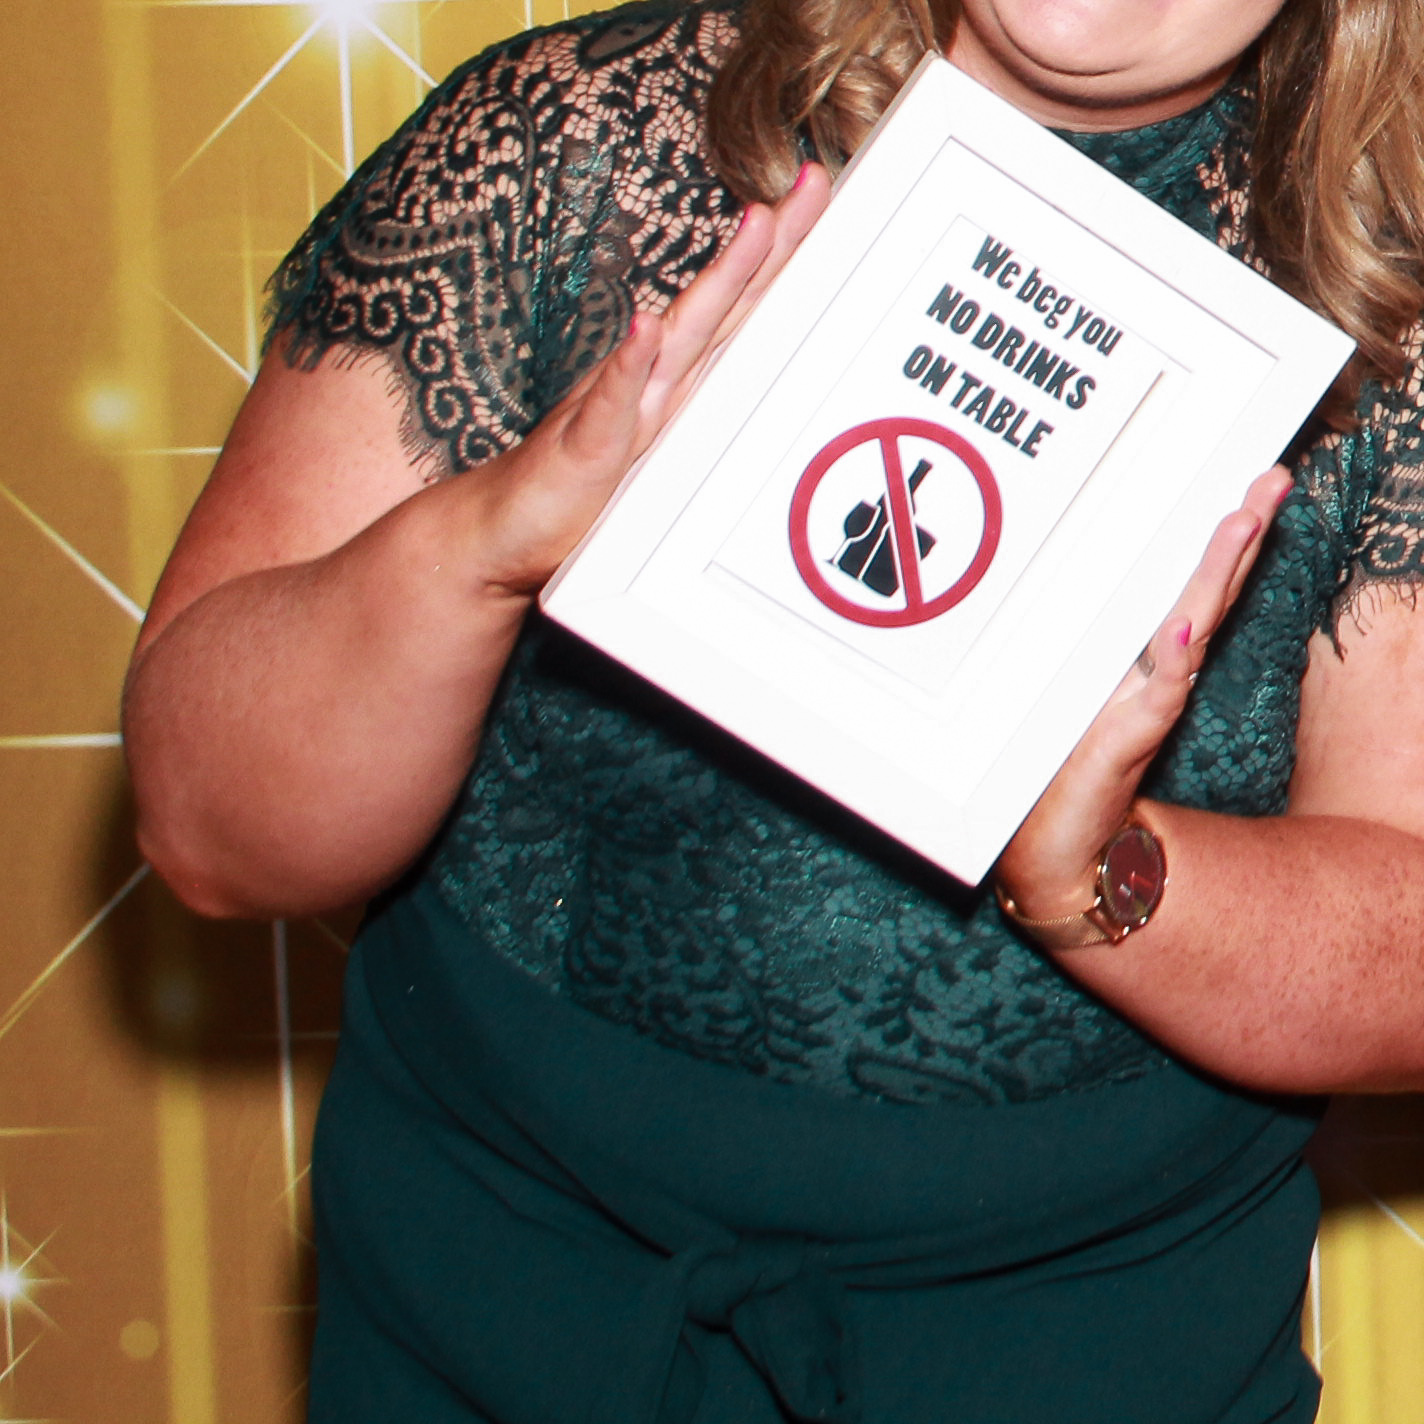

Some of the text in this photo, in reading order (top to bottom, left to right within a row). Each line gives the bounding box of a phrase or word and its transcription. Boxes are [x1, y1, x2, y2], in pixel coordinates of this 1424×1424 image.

[926, 283, 1097, 410] NO DRINKS
[971, 235, 1124, 357] We beg you
[902, 345, 1055, 458] ON TABLE
